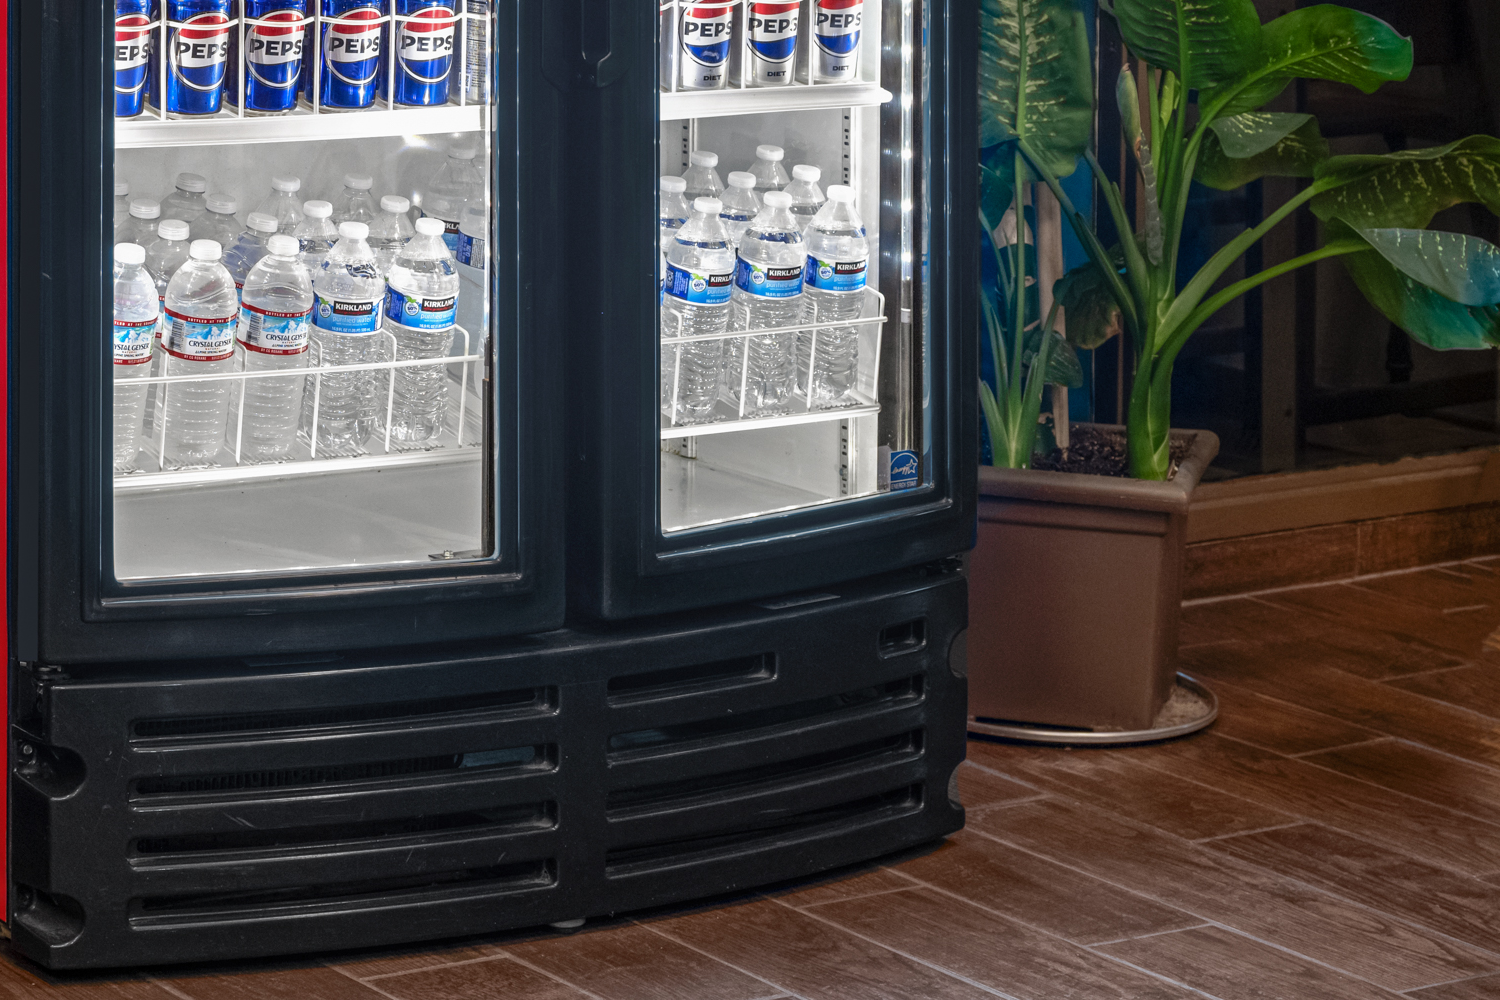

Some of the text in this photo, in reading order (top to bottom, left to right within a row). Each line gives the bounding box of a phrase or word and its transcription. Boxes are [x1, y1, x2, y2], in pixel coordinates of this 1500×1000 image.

[401, 34, 453, 52] PEPS
[703, 74, 722, 82] DIET
[767, 70, 787, 78] DIET
[769, 267, 801, 277] KIRKLAND
[335, 302, 372, 311] KIRKLAND
[424, 298, 454, 307] KIRKLAND
[265, 333, 290, 341] CRYSTAL
[131, 342, 150, 351] GEYSER
[188, 339, 215, 348] CRYSTAL
